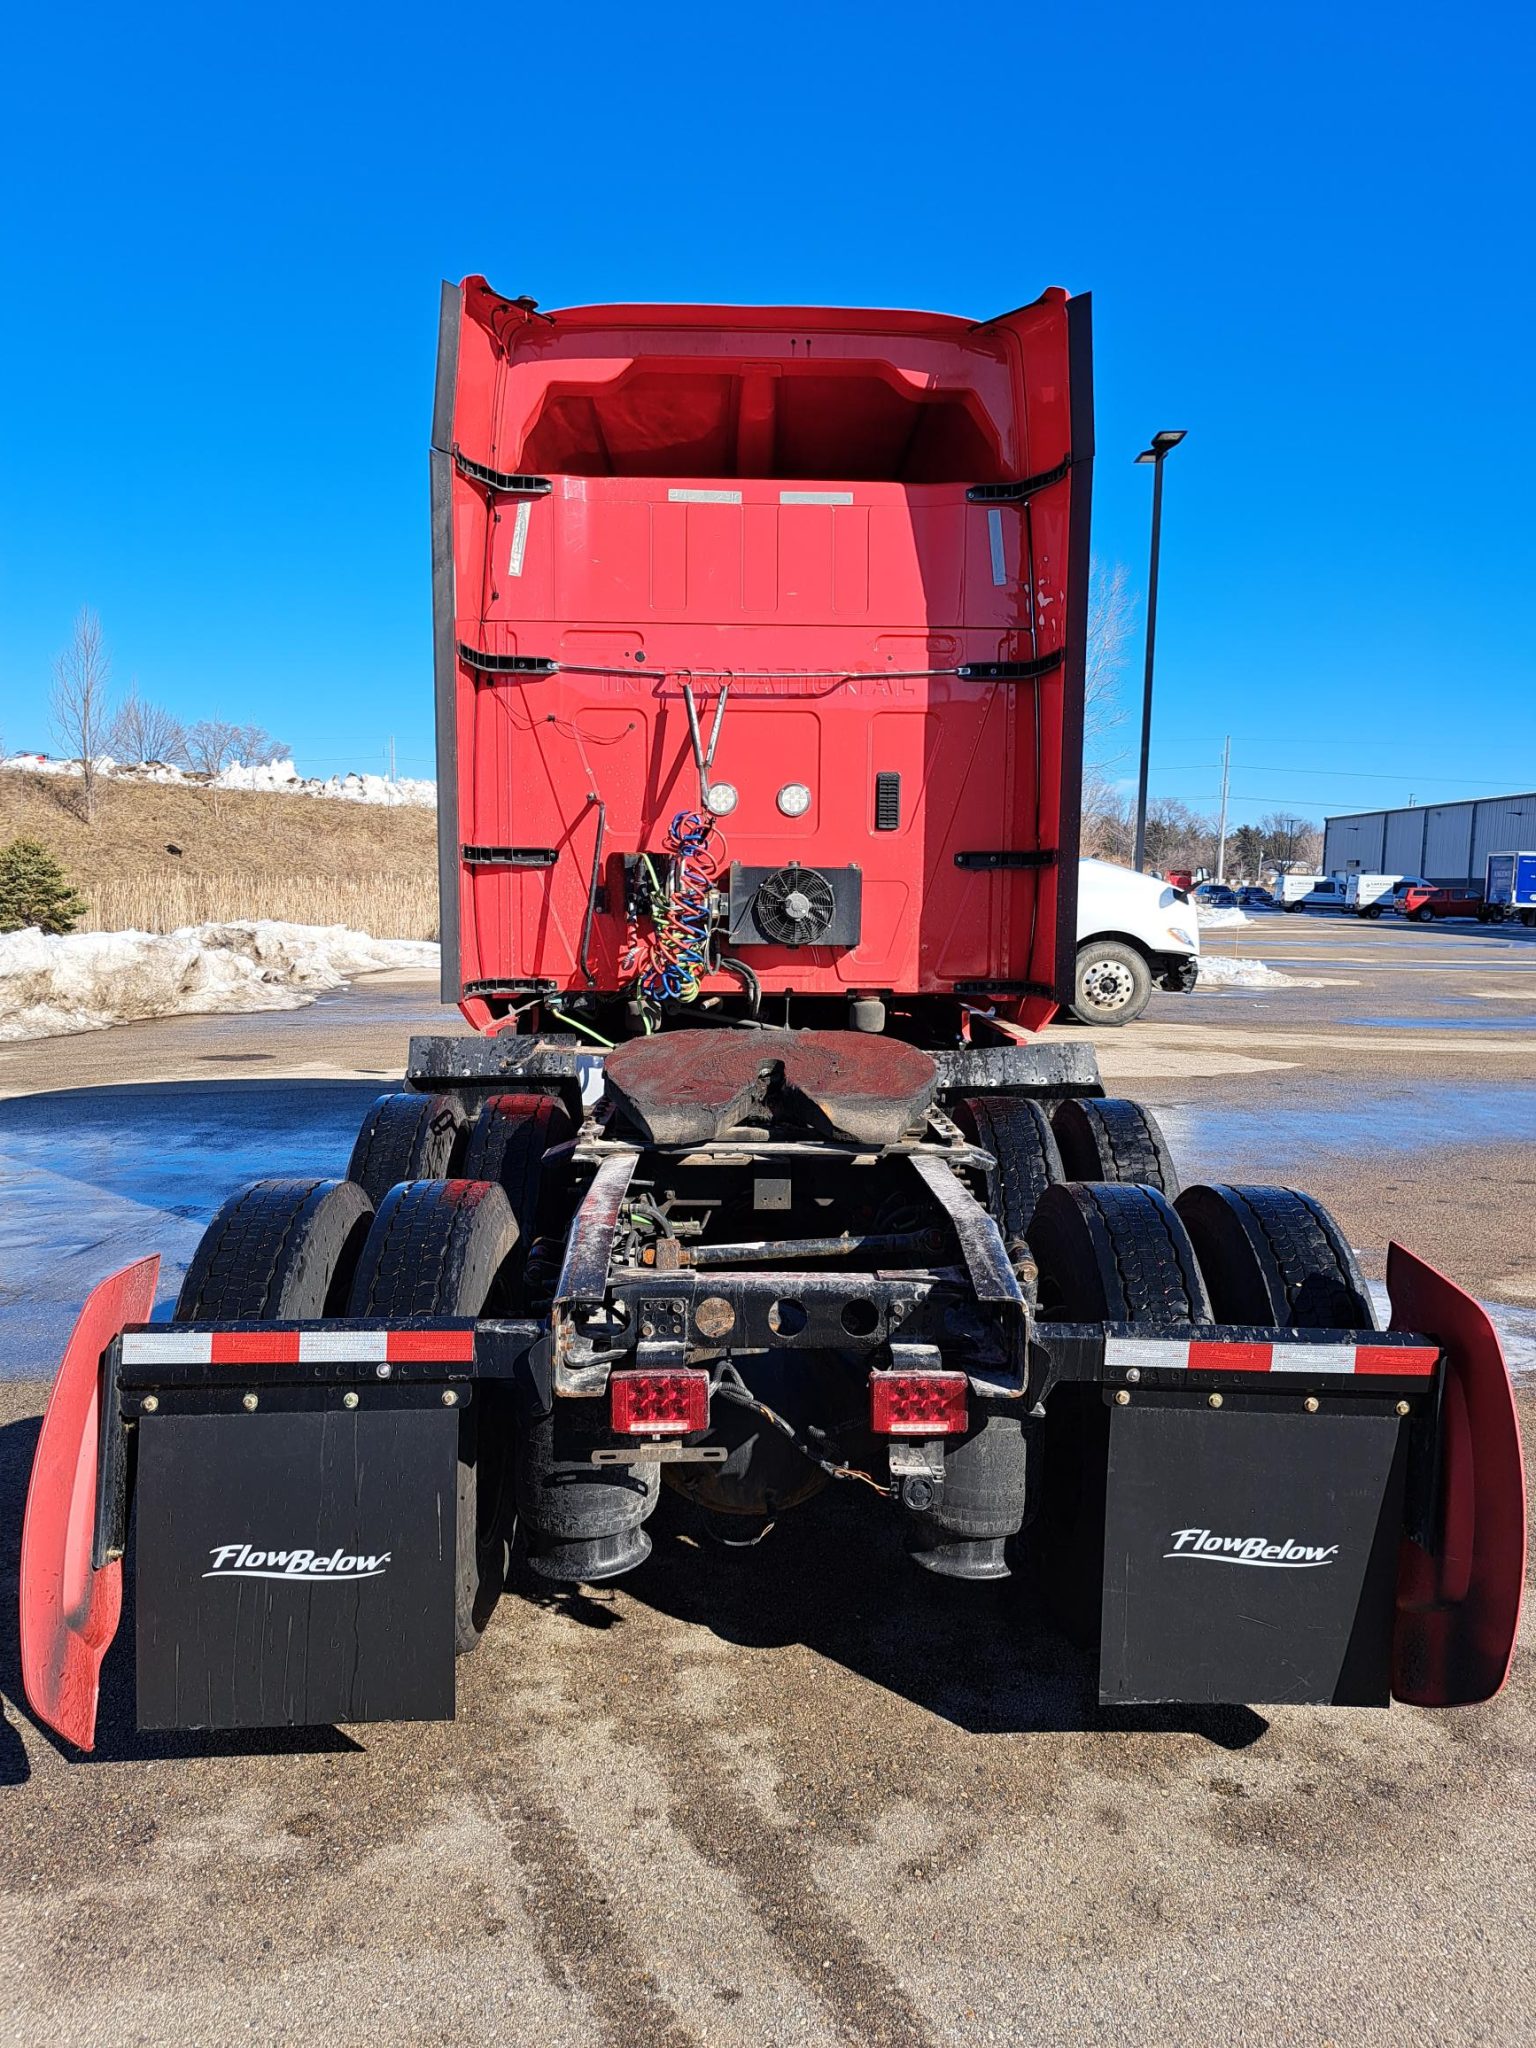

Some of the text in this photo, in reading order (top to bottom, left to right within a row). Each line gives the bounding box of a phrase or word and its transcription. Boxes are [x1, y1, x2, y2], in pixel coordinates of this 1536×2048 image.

[600, 665, 915, 695] INTERNATIONAL
[209, 1544, 391, 1573] FlowBelow
[1171, 1529, 1339, 1561] FlowBelow
